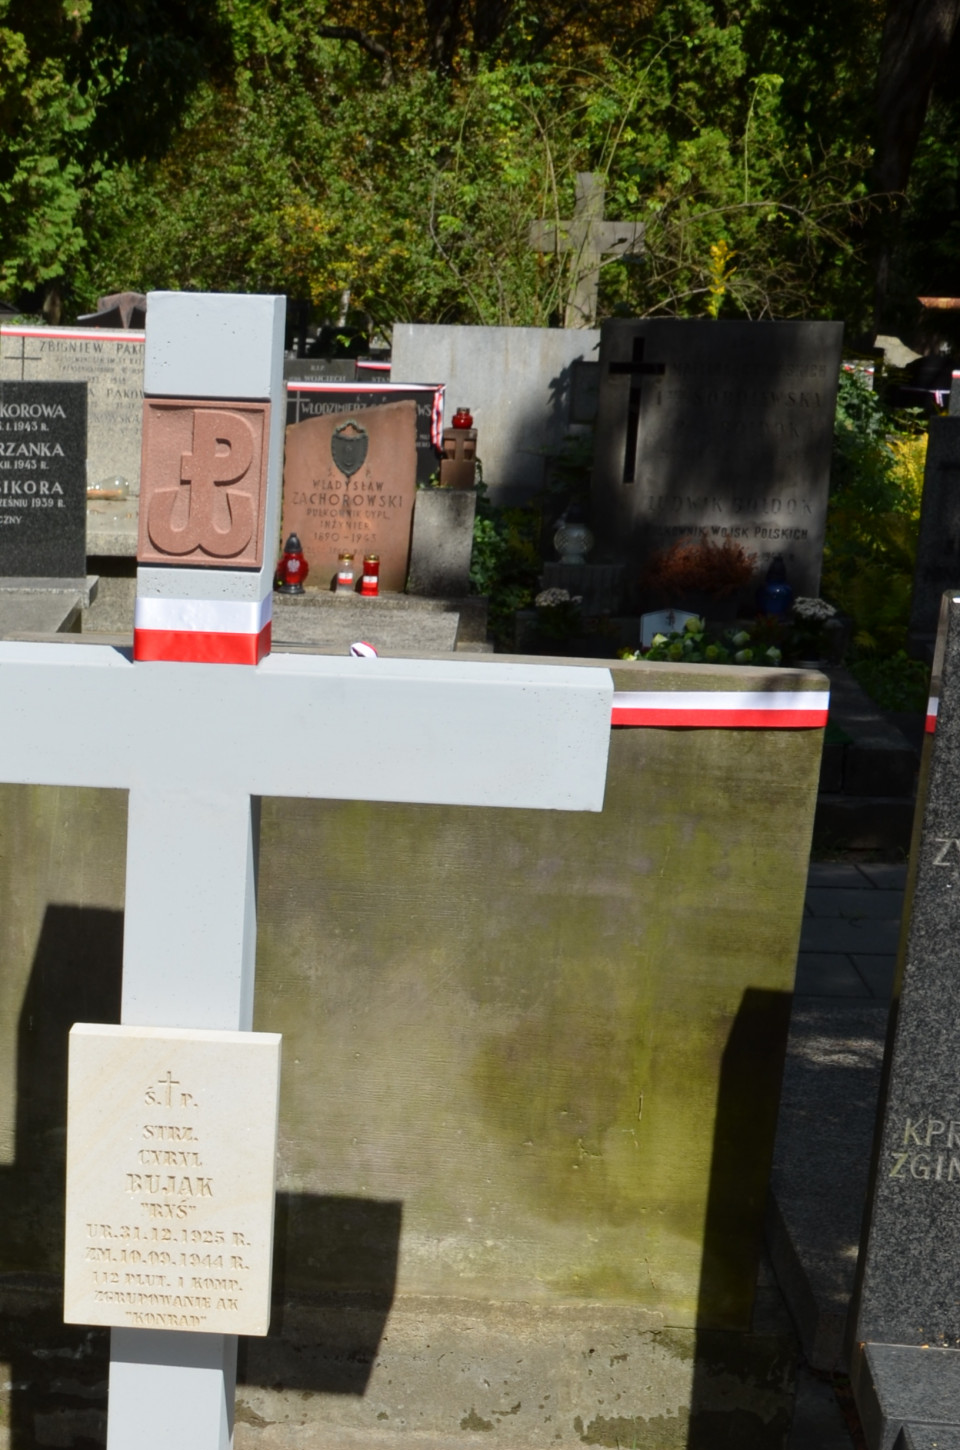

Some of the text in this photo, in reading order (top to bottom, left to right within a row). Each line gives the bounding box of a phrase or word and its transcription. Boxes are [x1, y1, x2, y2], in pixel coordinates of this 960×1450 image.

[40, 341, 104, 354] ZBIGNIEW
[312, 479, 384, 492] WŁADYSŁAW
[32, 498, 54, 508] 1939
[292, 492, 403, 508] ZACHOROWSKI
[710, 525, 750, 539] WOJSK
[755, 526, 809, 541] POLSKICH
[144, 1086, 199, 1107] Ś. P.
[143, 1125, 199, 1142] STRZ.
[139, 1149, 203, 1167] CYRYL
[125, 1173, 214, 1198] BUJAK
[232, 1231, 252, 1247] R.
[230, 1255, 250, 1270] R.
[92, 1271, 119, 1285] 112
[125, 1272, 171, 1288] PLUT.
[192, 1276, 244, 1292] KOMP.
[94, 1289, 239, 1311] ZGRUPOWANIE AK
